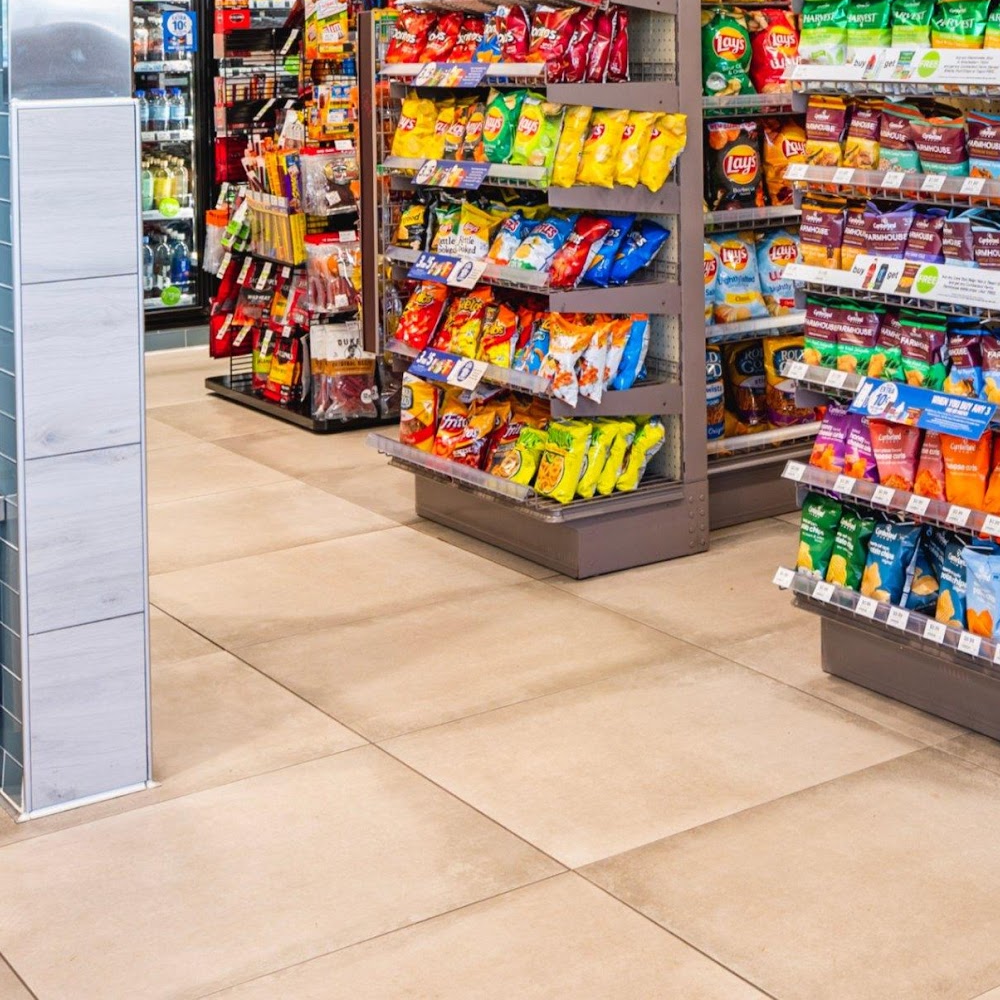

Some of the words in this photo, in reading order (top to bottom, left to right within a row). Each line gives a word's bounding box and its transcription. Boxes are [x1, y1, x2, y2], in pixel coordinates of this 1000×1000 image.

[716, 31, 745, 54] Lay's
[727, 155, 756, 175] Lay's
[800, 224, 829, 236] ARMHOUSE
